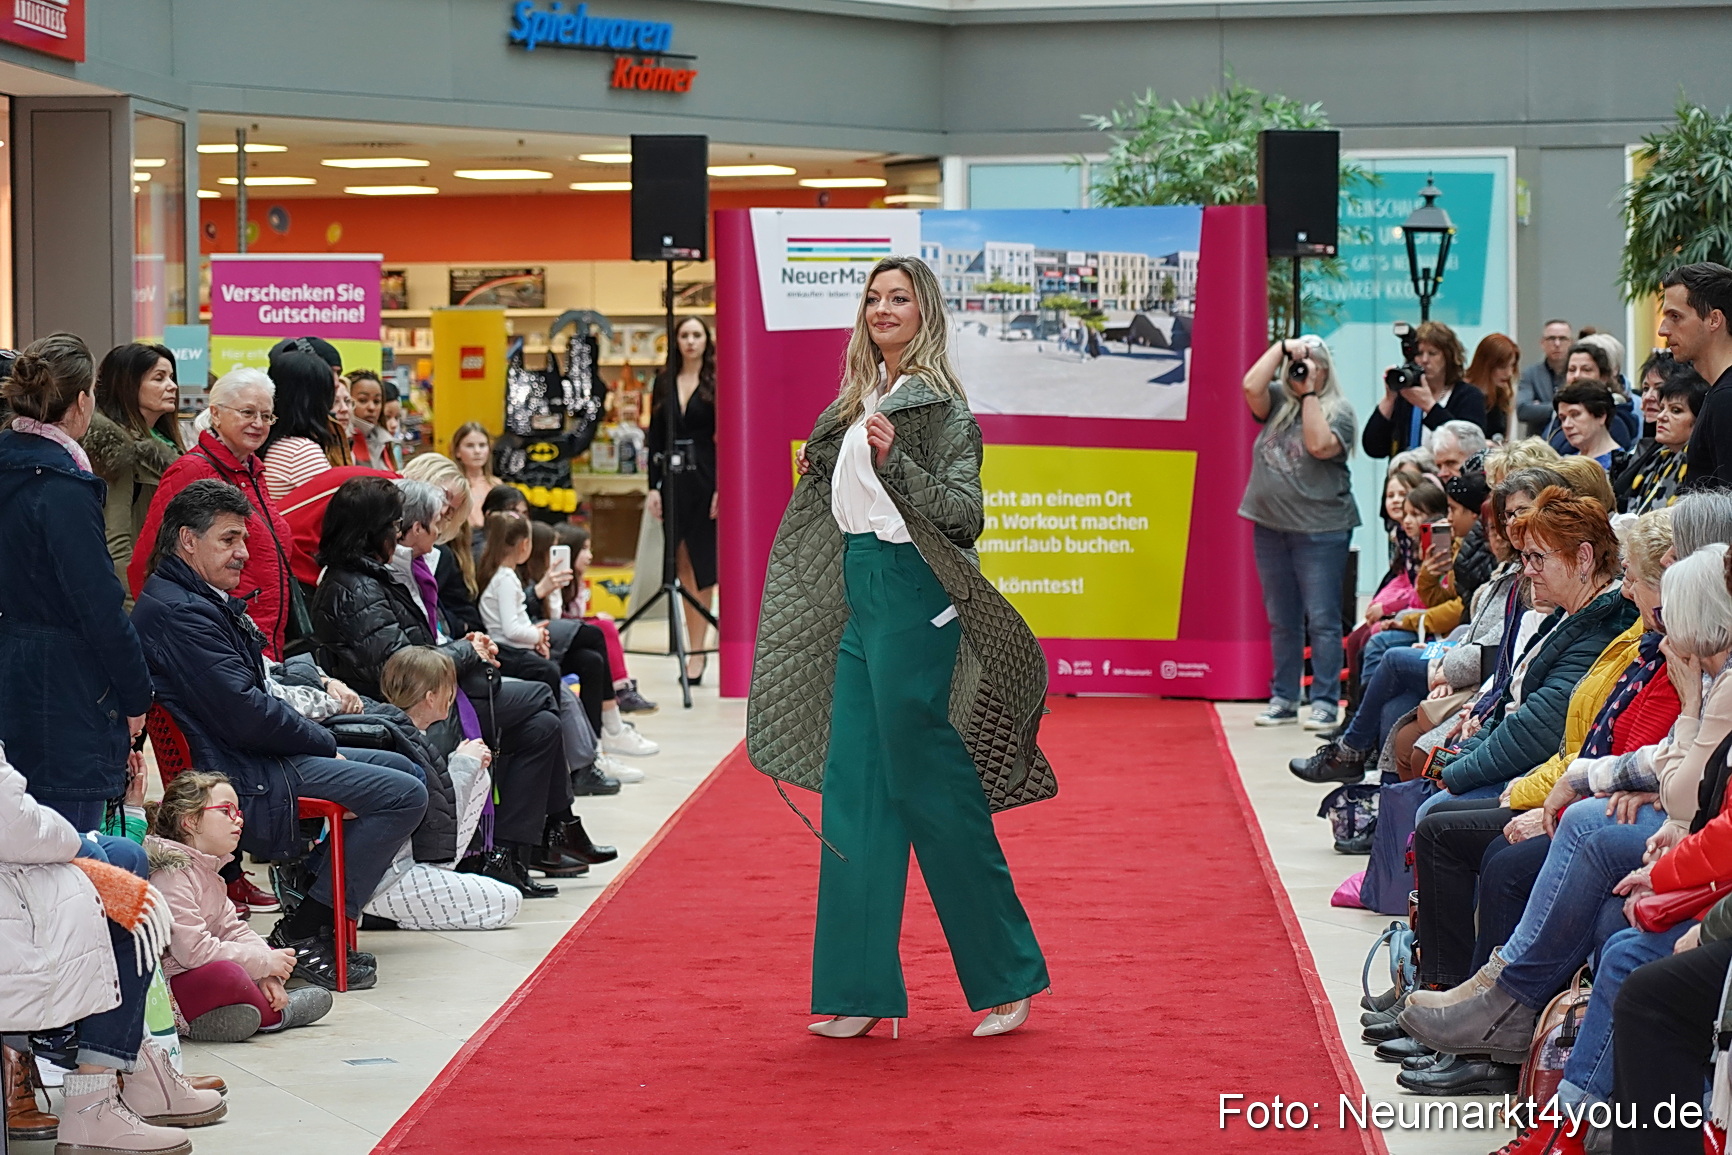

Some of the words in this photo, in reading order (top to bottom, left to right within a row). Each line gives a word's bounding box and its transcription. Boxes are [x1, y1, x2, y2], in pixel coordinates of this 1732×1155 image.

[509, 0, 673, 51] Spielwaren
[611, 57, 698, 93] Krömer
[781, 267, 867, 285] NeuerMa
[220, 283, 335, 302] Verschenken
[337, 283, 365, 302] Sie
[258, 304, 366, 324] Gutscheine!
[982, 489, 1017, 508] icht
[1020, 492, 1043, 508] an
[1046, 489, 1102, 508] einem
[1104, 489, 1133, 508] Ort
[1001, 512, 1078, 531] Workout
[1080, 513, 1149, 531] machen
[975, 536, 1062, 554] umurlaub
[1064, 535, 1135, 554] buchen.
[998, 576, 1085, 595] könntest!
